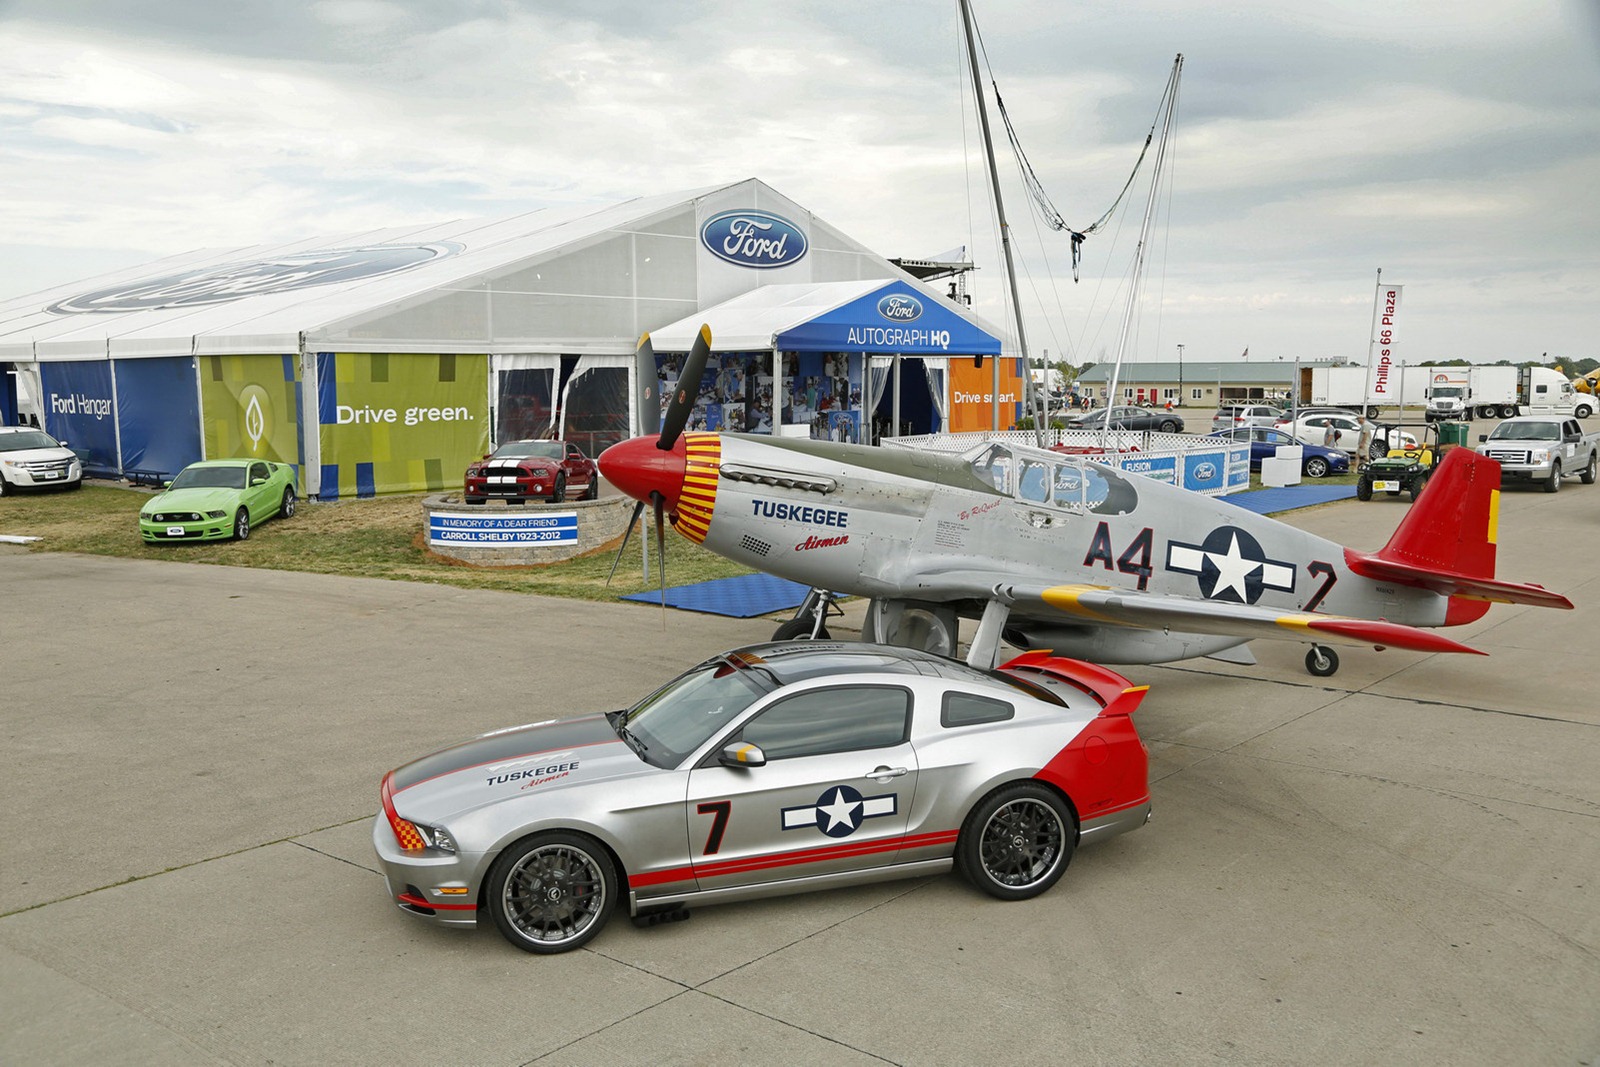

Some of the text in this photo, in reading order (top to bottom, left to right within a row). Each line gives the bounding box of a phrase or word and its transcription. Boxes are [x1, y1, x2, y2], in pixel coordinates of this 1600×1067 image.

[724, 217, 788, 260] Ford
[887, 297, 915, 319] Ford
[847, 327, 950, 350] AUTOGRAPH HQ
[1375, 290, 1396, 393] Phillips 66 Plaza
[51, 393, 111, 420] Ford Hangar
[954, 391, 1016, 403] Drive sart.
[336, 405, 474, 426] Drive green.
[1126, 462, 1151, 471] FUSION
[1197, 465, 1213, 479] Ford
[450, 519, 482, 527] MEMORY
[504, 519, 527, 527] DEAR
[528, 518, 559, 527] FRIEND
[752, 499, 849, 528] TUSKEGEE
[441, 531, 561, 541] CARROLL SHELBY 1923-2012
[794, 534, 849, 552] Airmen
[487, 761, 580, 786] TUSKEGEE
[520, 771, 570, 790] Airmen
[697, 800, 731, 856] 7
